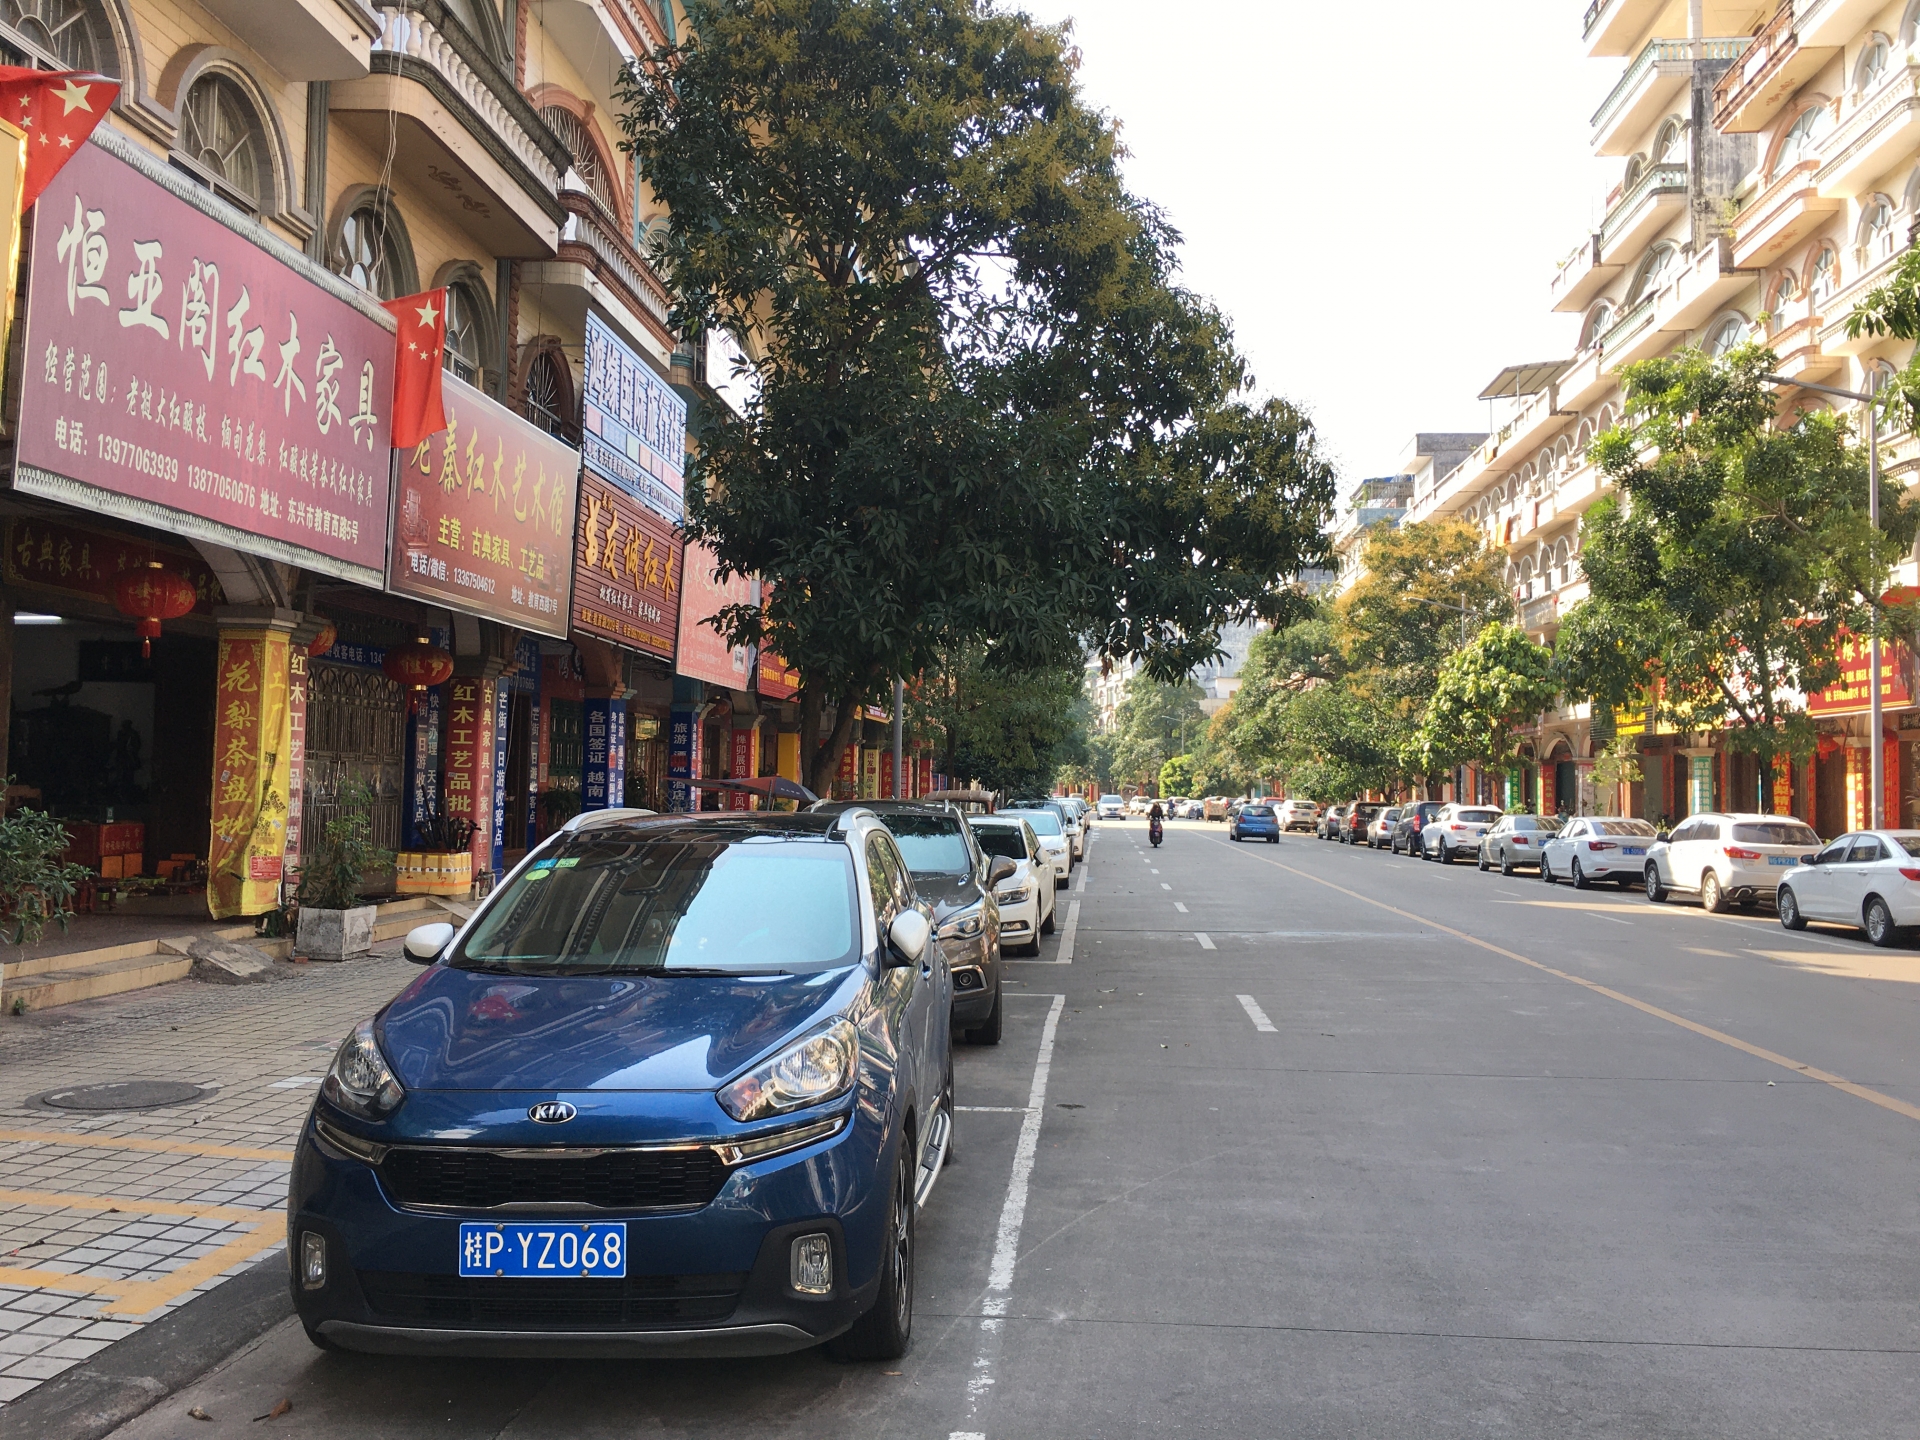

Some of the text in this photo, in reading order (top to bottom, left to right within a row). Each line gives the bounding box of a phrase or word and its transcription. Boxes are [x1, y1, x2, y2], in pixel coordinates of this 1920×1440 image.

[57, 194, 378, 452] 恒亚阁红木家具
[187, 464, 256, 508] 13877050676
[438, 514, 545, 581] 主营：古典家具、工艺品
[428, 693, 440, 756] 快速办理
[588, 710, 607, 764] 各国签证
[673, 722, 688, 745] 旅游
[494, 691, 508, 846] 芒街一日游收客点
[866, 751, 876, 798] 批发品半成
[535, 1105, 567, 1119] KIA
[465, 1231, 622, 1269] 桂P·YZ068
